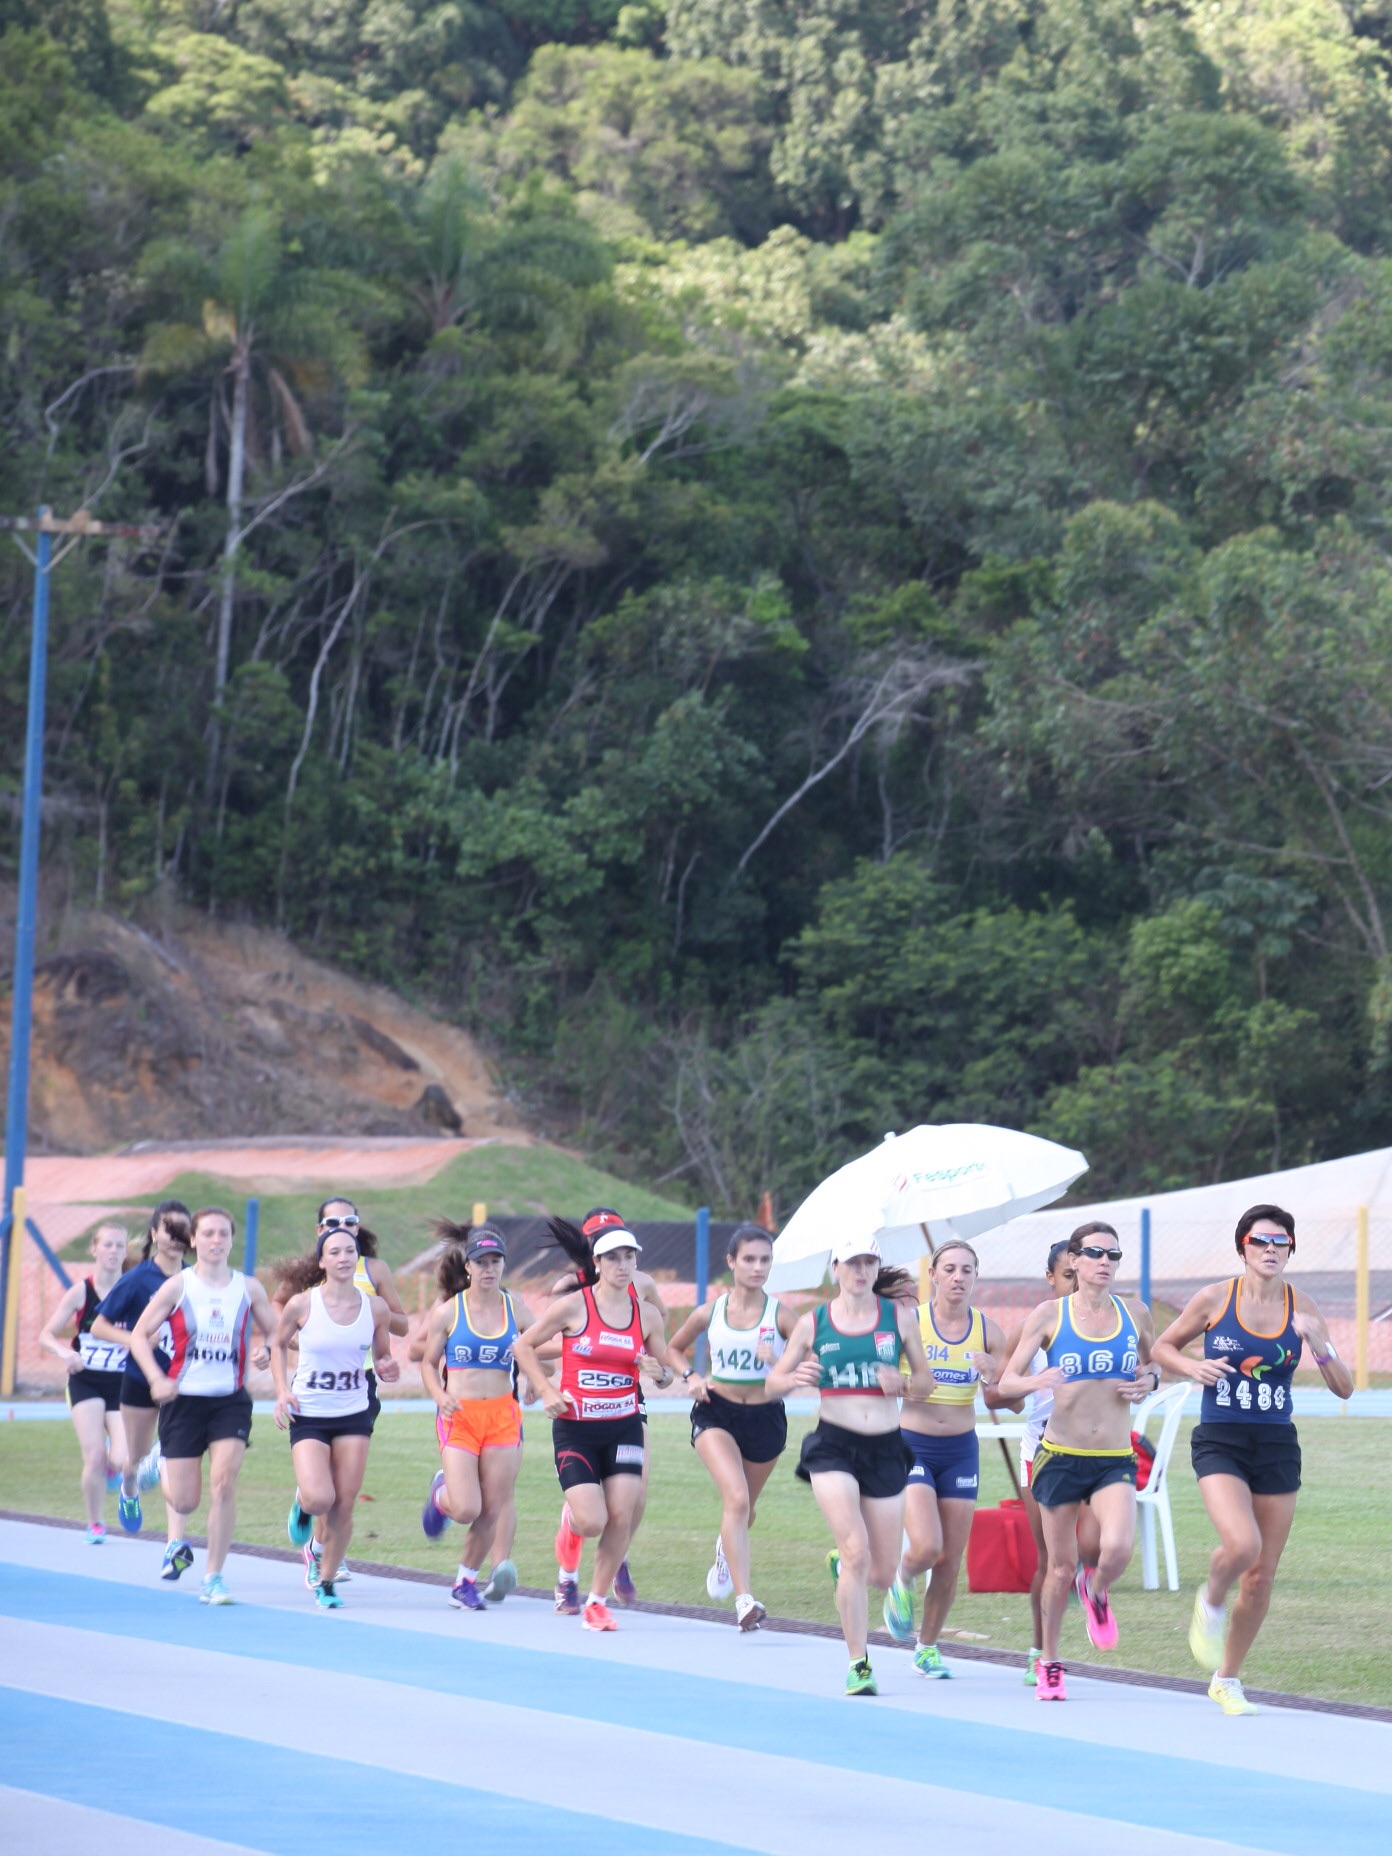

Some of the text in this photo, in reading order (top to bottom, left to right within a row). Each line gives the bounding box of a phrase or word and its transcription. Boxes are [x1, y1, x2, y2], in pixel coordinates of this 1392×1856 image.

[1059, 1350, 1137, 1377] 860
[307, 1368, 360, 1391] 1331
[930, 1370, 967, 1381] omes
